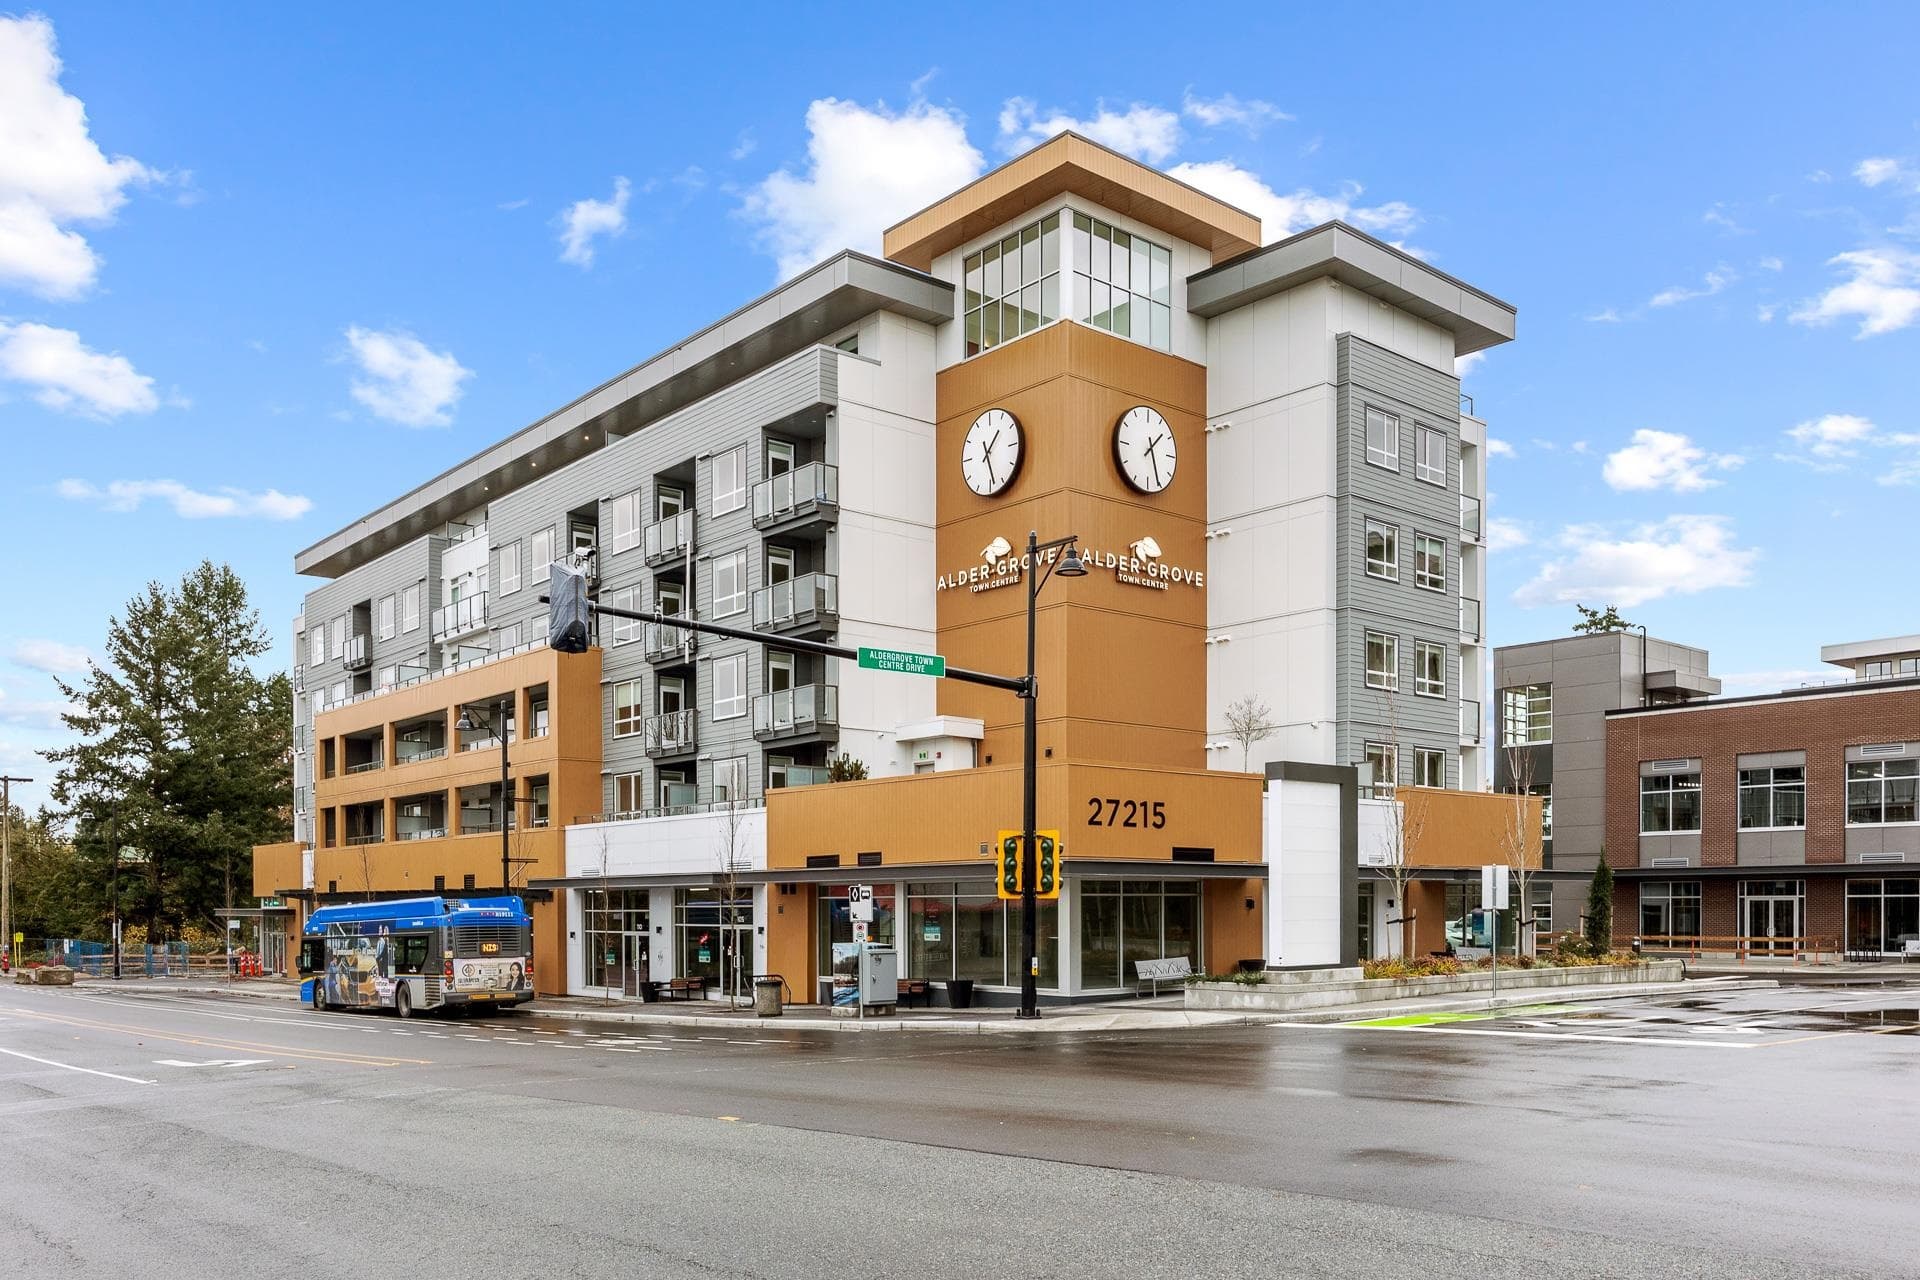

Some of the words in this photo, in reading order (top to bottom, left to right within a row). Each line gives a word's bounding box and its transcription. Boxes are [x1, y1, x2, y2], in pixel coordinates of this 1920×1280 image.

[969, 582, 990, 593] TOWN
[992, 575, 1019, 588] CENTRE
[1118, 573, 1139, 584] TOWN
[1141, 578, 1169, 590] CENTRE
[869, 651, 913, 663] ALDERGROVE
[915, 656, 934, 665] TOWN
[878, 660, 905, 670] CENTRE
[906, 663, 925, 672] DRIVE
[1087, 797, 1166, 830] 27215
